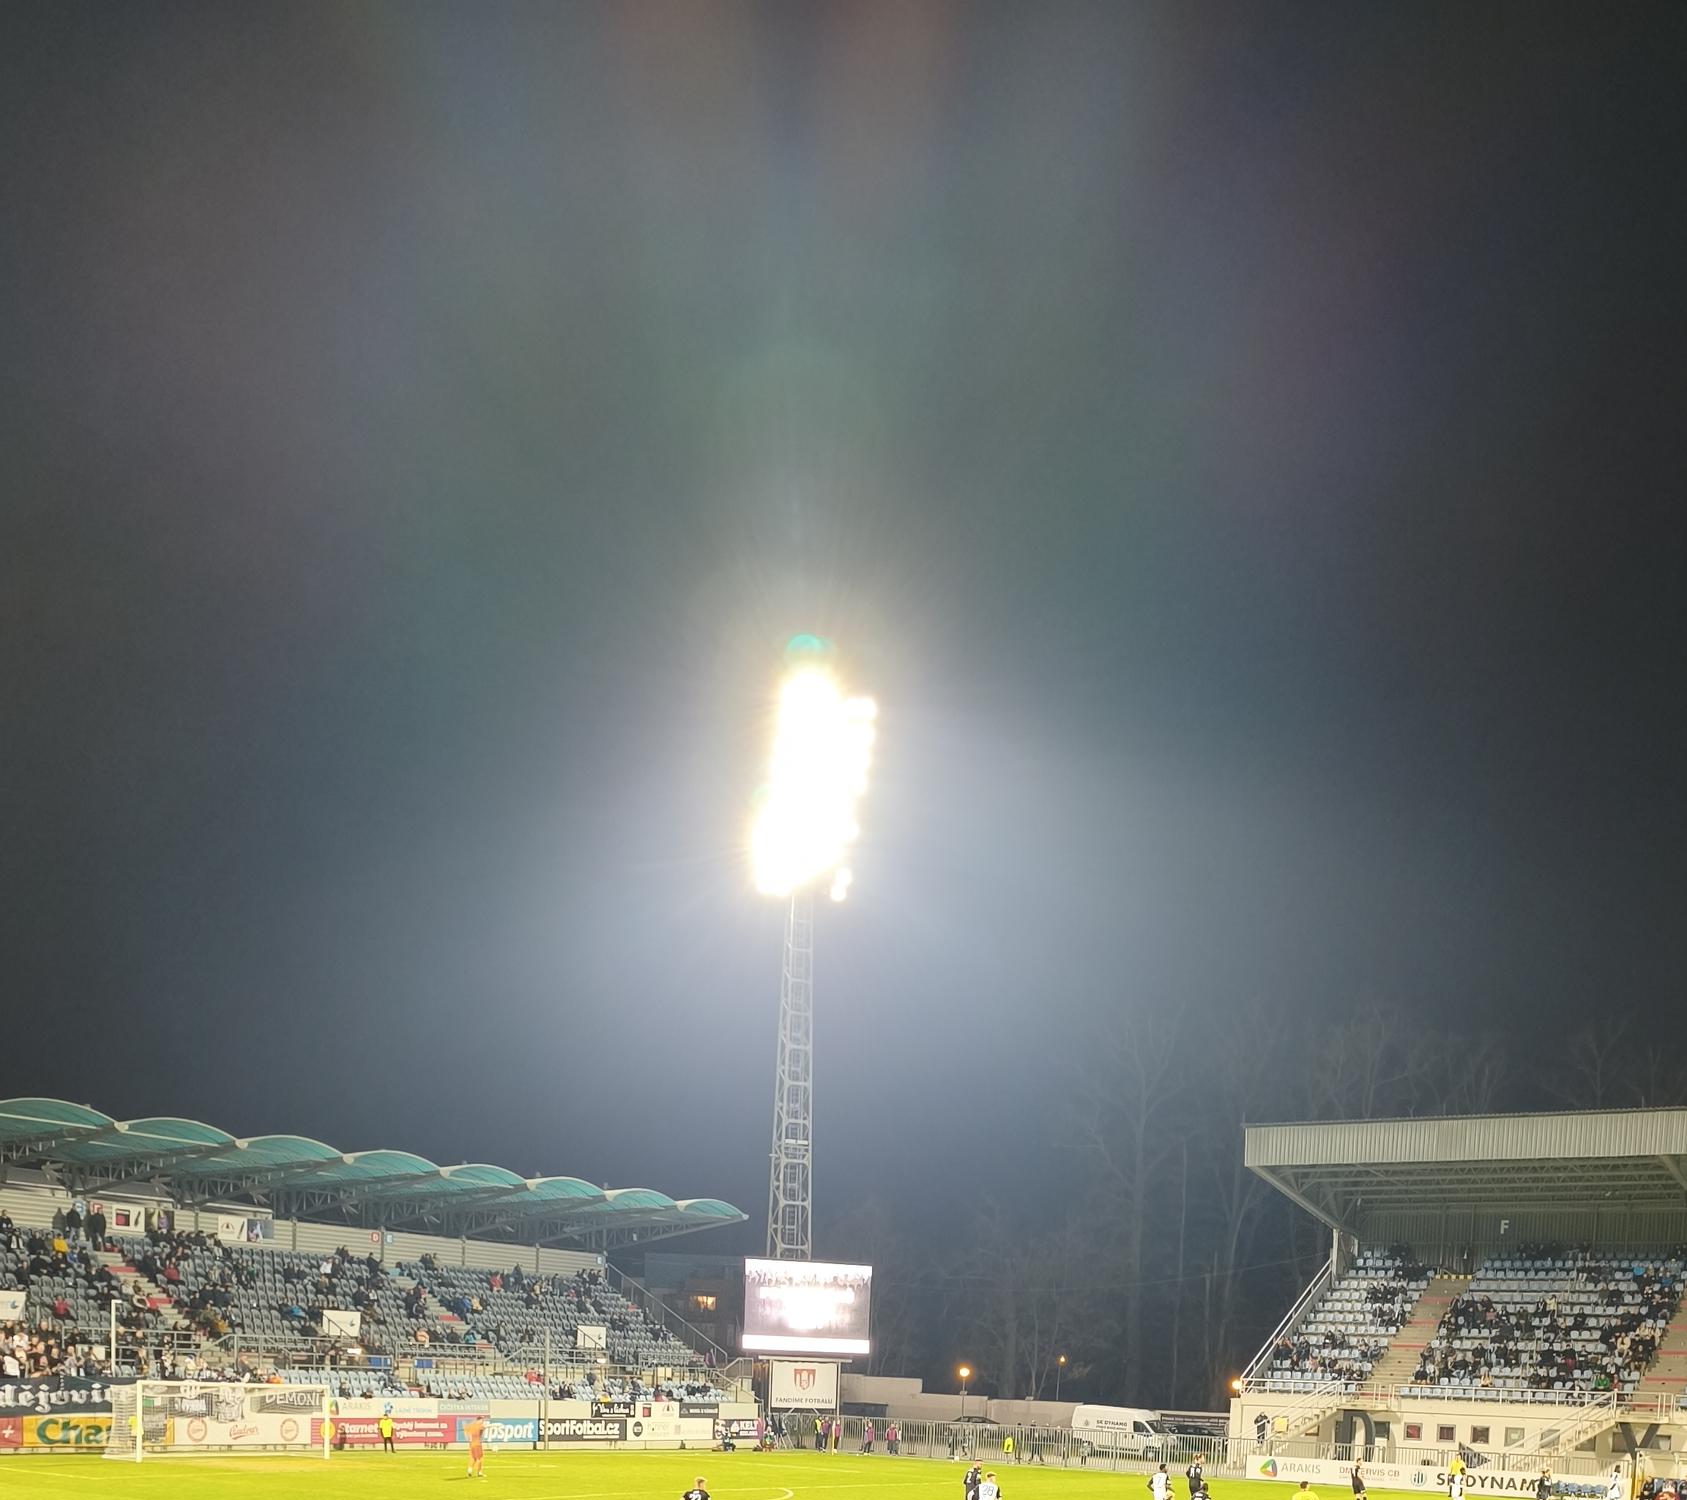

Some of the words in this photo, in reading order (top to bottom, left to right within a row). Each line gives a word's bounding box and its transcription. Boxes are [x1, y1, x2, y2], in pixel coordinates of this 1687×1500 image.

[1501, 1220, 1510, 1235] F
[36, 1418, 113, 1445] Cha
[484, 1418, 533, 1442] ipsport
[1281, 1462, 1321, 1474] ARAKIS
[982, 1484, 995, 1497] 28
[1465, 1475, 1537, 1492] DYNAM
